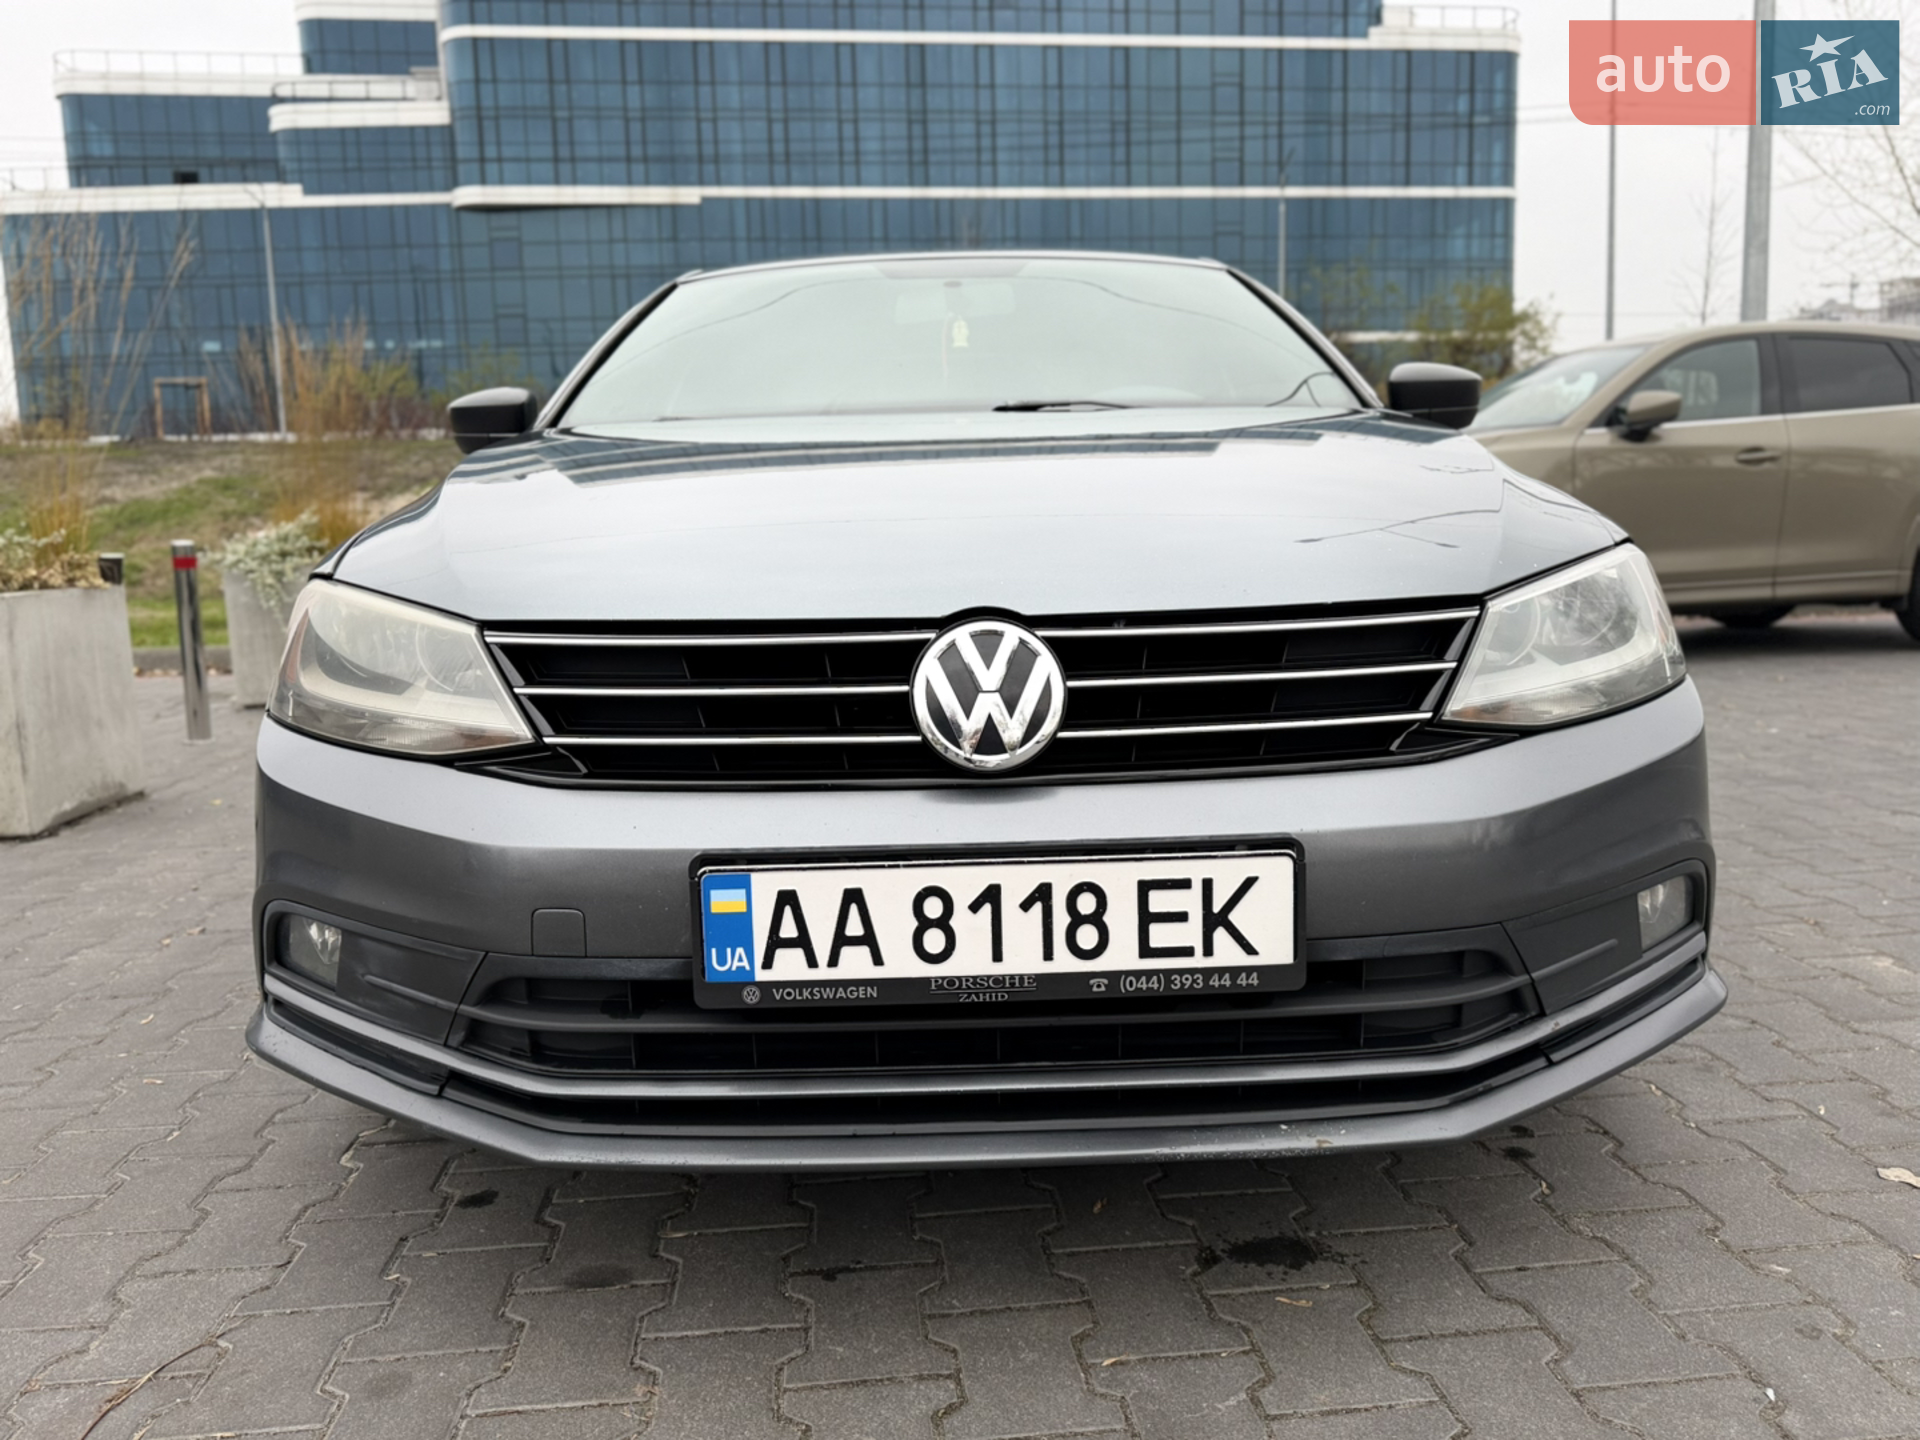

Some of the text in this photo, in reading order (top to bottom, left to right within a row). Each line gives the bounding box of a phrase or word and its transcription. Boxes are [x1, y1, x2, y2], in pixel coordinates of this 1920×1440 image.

[761, 876, 1259, 970] AA 8118 EK
[711, 947, 750, 972] UA
[930, 975, 1037, 990] PORSCHE
[1120, 972, 1259, 993] (044) 393 44 44
[772, 986, 878, 1001] VOLKSWAGEN
[959, 992, 1009, 1002] ZAHID
